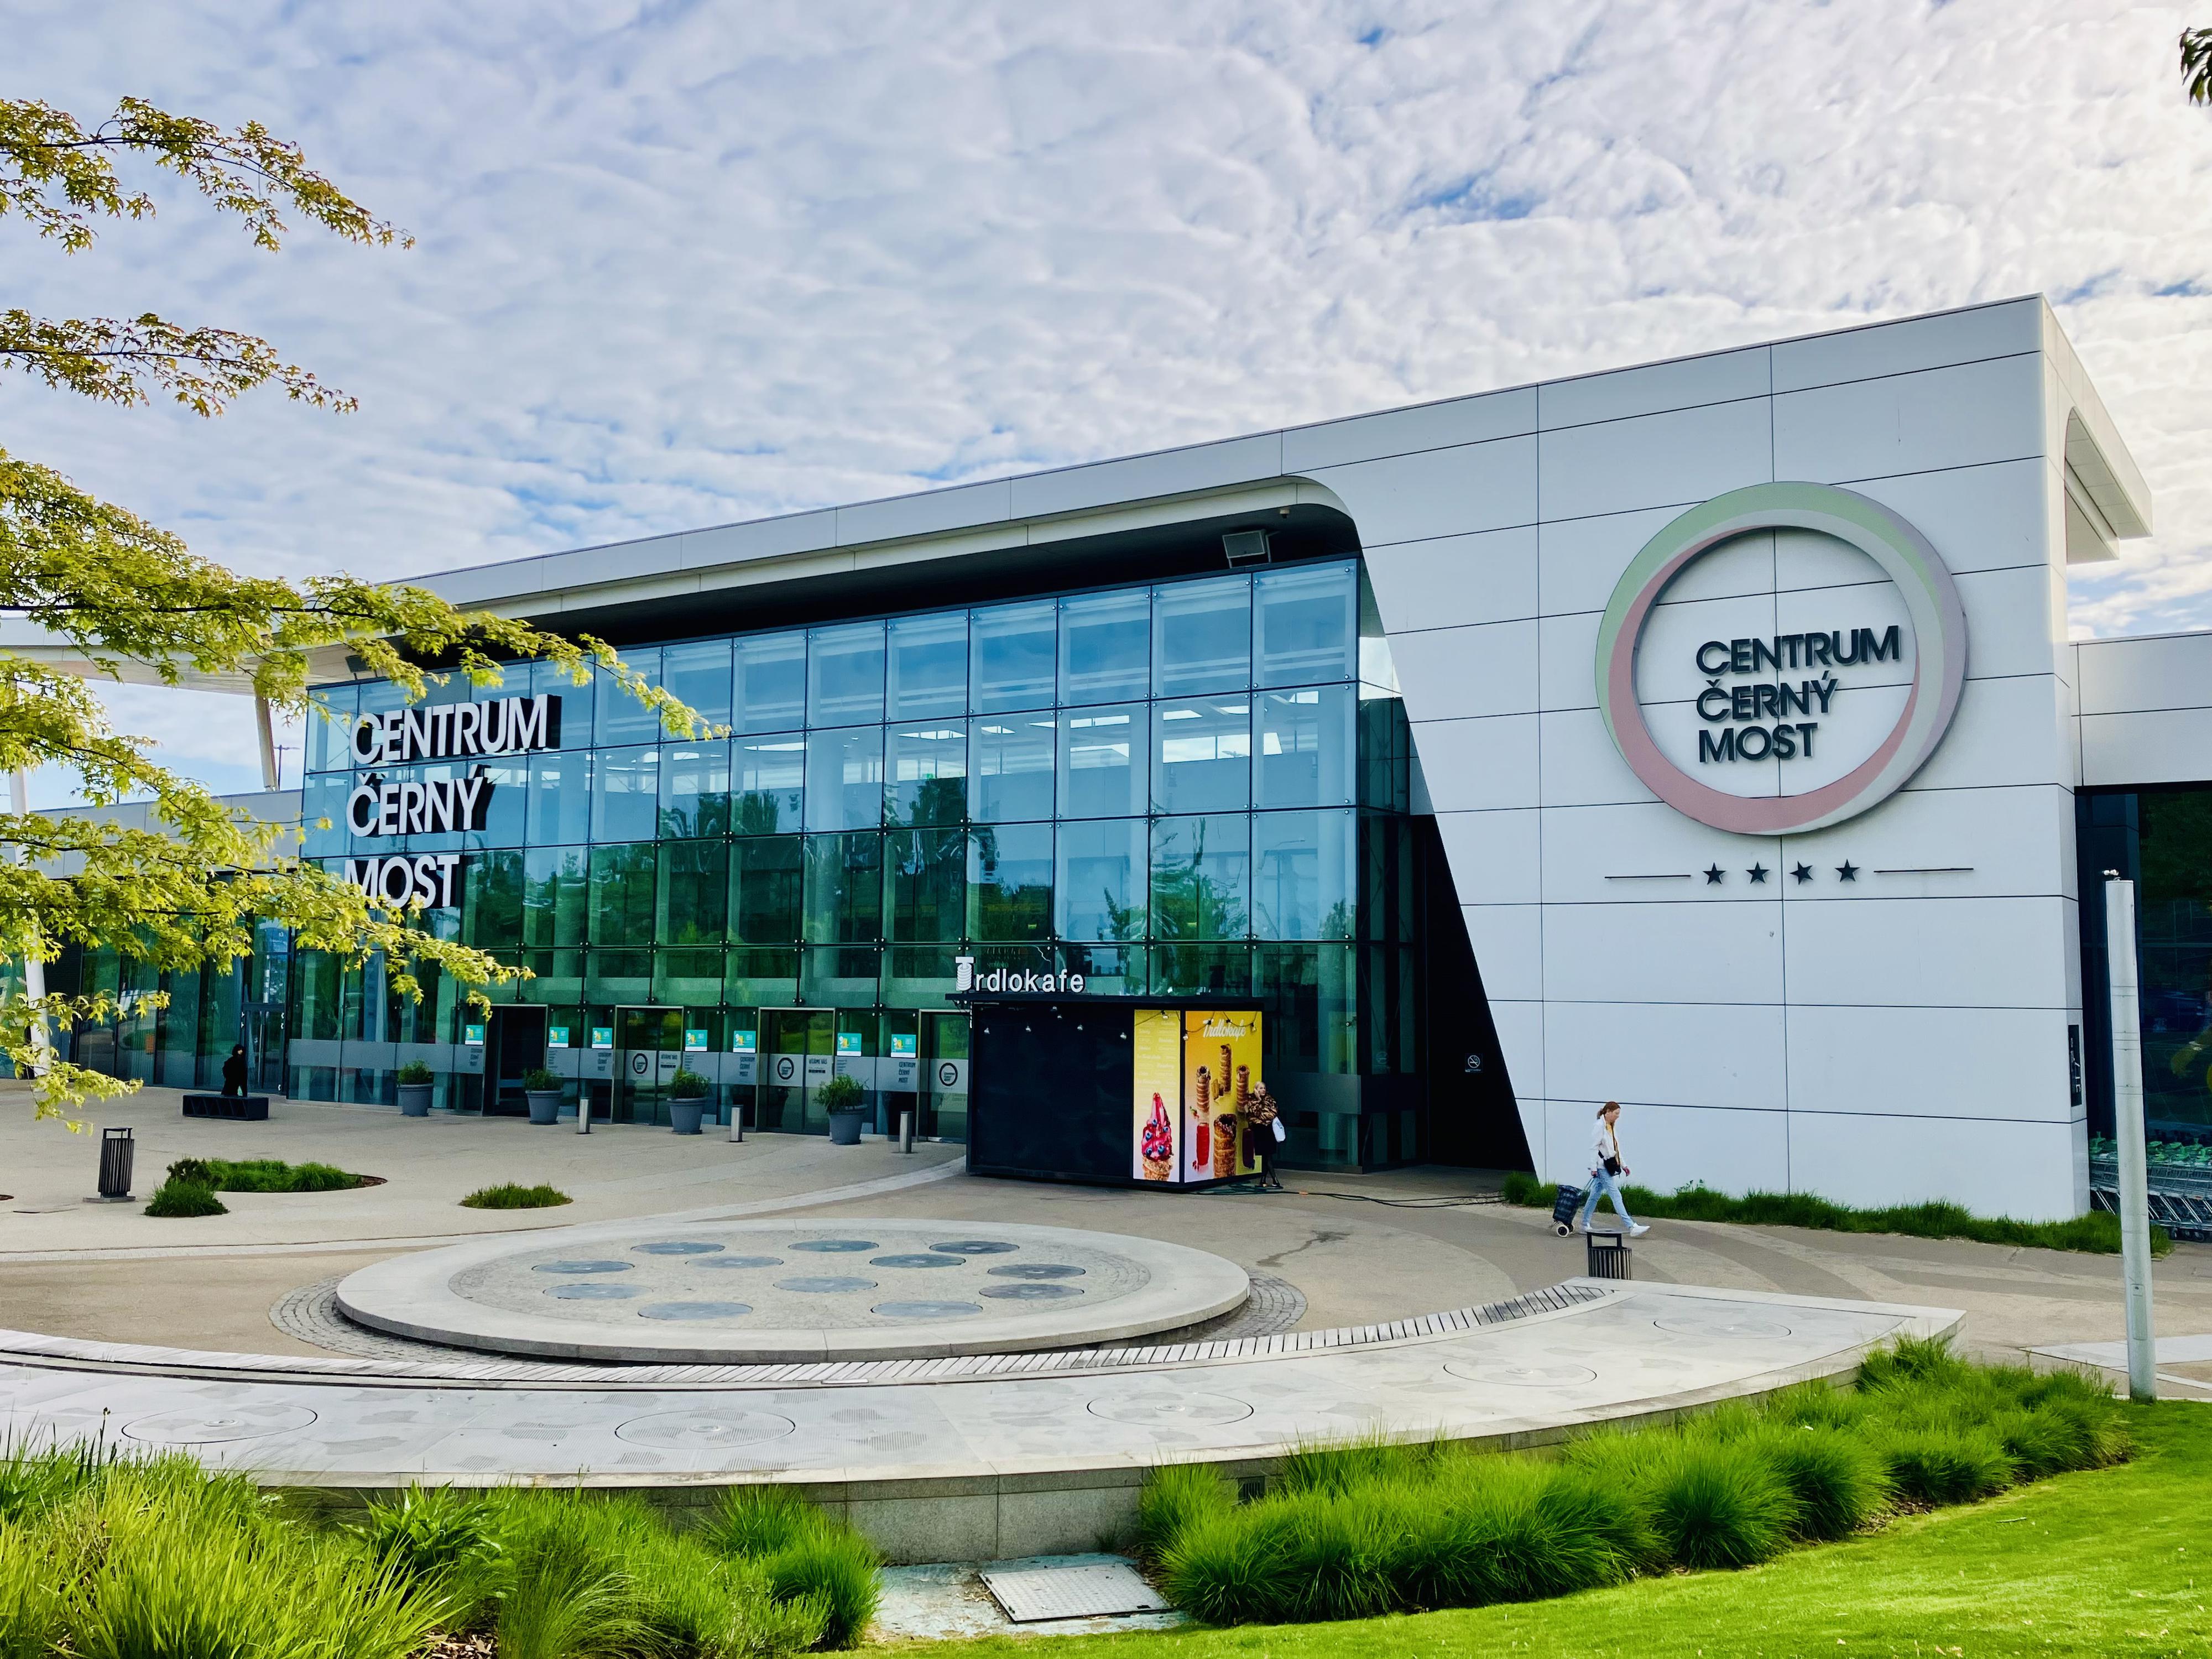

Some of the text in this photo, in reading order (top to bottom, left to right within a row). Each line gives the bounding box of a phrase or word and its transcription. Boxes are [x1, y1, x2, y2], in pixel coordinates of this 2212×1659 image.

[1695, 625, 1900, 675] CENTRUM
[1695, 670, 1839, 722] ČERNÝ
[350, 693, 553, 764] CENTRUM
[1698, 722, 1819, 763] MOST
[346, 764, 487, 837] ČERNÝ
[344, 854, 460, 909] MOST
